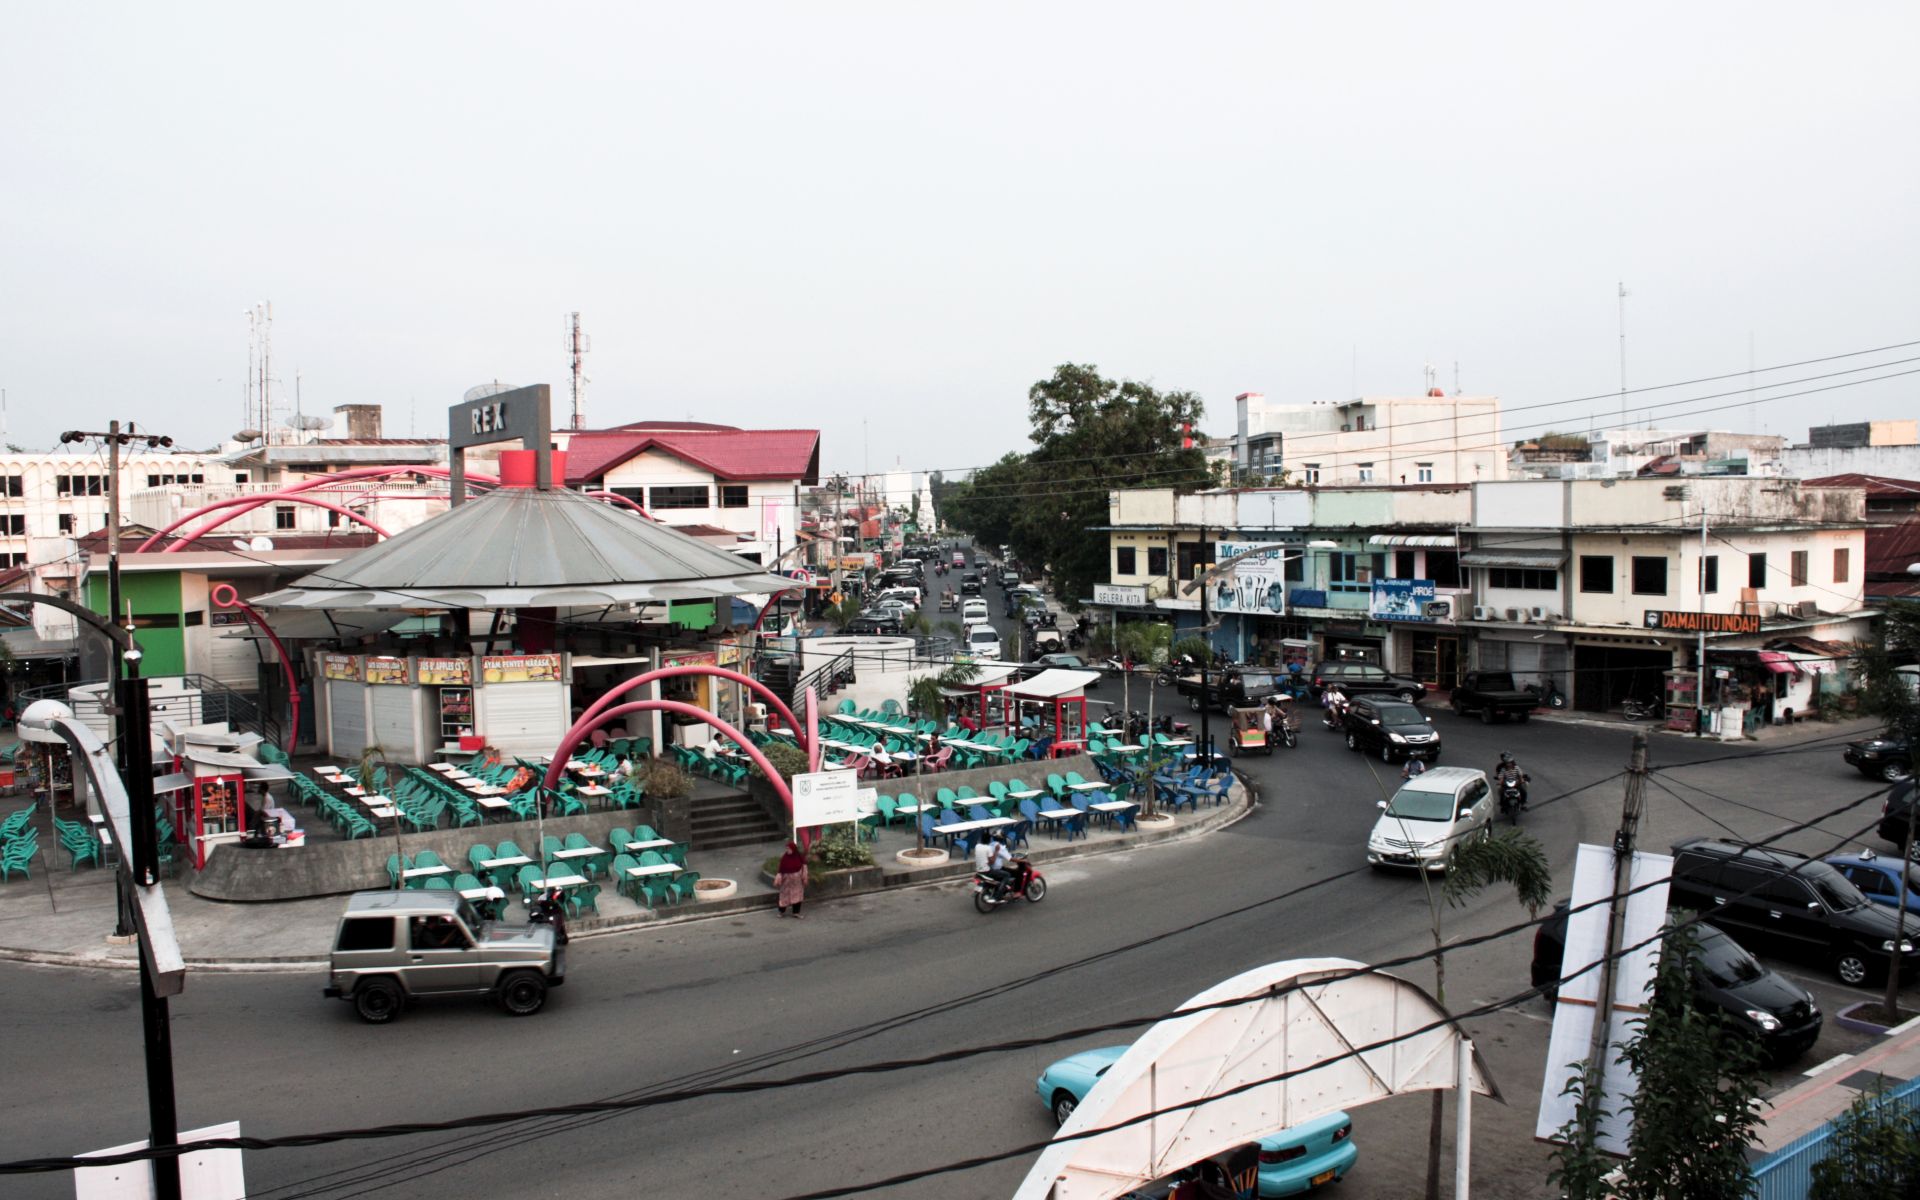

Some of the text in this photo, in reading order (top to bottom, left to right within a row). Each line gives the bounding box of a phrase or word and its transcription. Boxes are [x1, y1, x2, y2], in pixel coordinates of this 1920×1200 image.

[472, 402, 504, 434] REX
[1098, 592, 1141, 604] SELERA KITA
[1662, 611, 1700, 630] DAMAI
[1721, 614, 1759, 633] INDAH
